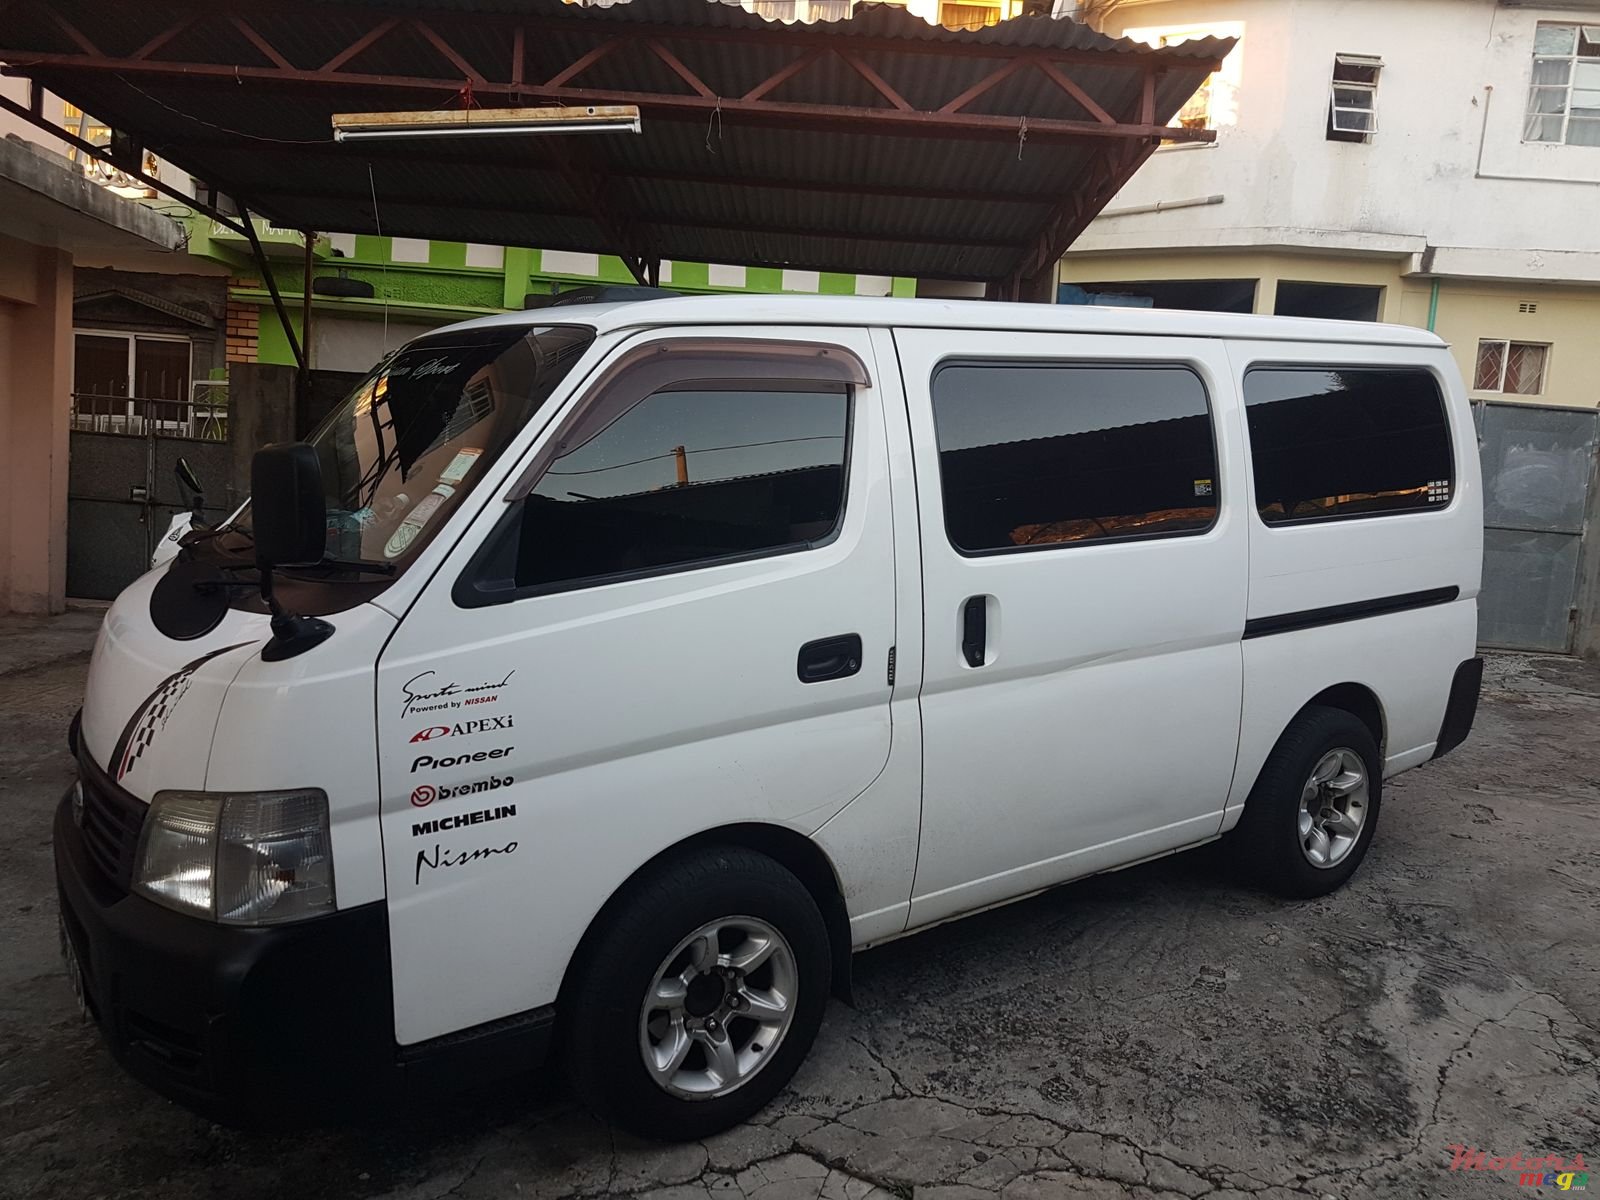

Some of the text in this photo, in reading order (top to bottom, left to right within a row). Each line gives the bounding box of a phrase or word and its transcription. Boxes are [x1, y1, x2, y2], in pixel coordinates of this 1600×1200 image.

[401, 670, 515, 719] Sports mind
[410, 695, 498, 714] Powered by NISSAN
[451, 715, 514, 737] APEXi
[410, 747, 514, 773] Pioneer
[438, 775, 514, 801] brembo
[412, 804, 517, 837] MICHELIN
[416, 841, 518, 885] Nismo
